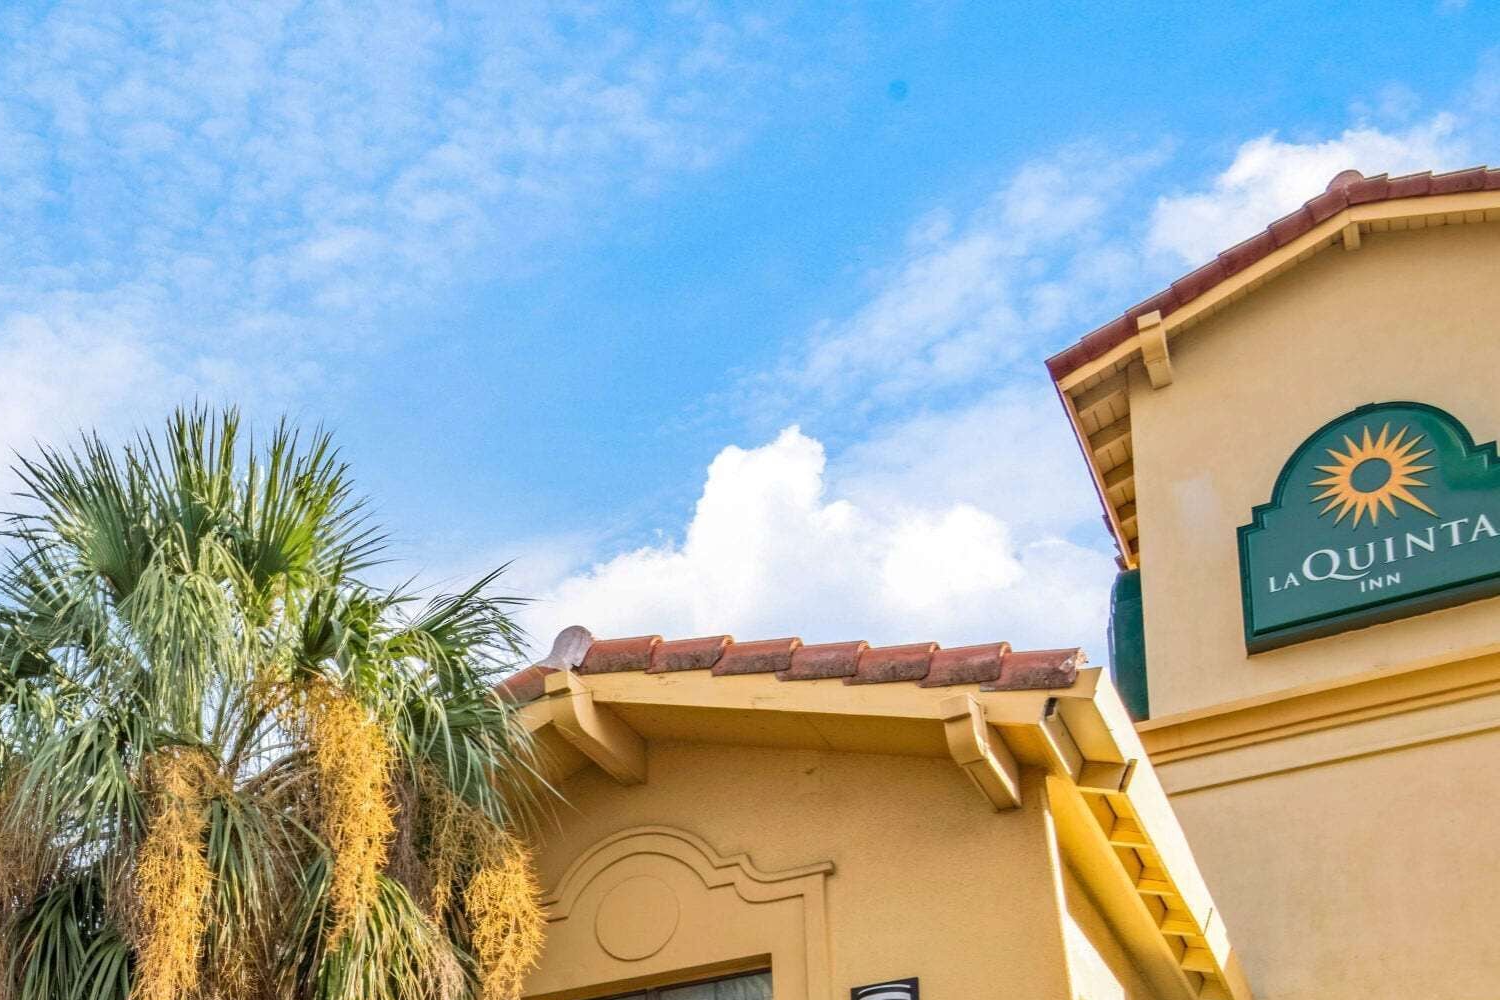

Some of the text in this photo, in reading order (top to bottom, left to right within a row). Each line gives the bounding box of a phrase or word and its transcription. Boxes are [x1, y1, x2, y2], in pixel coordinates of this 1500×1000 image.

[1268, 513, 1500, 593] LA QUINTA
[1360, 572, 1401, 593] INN
